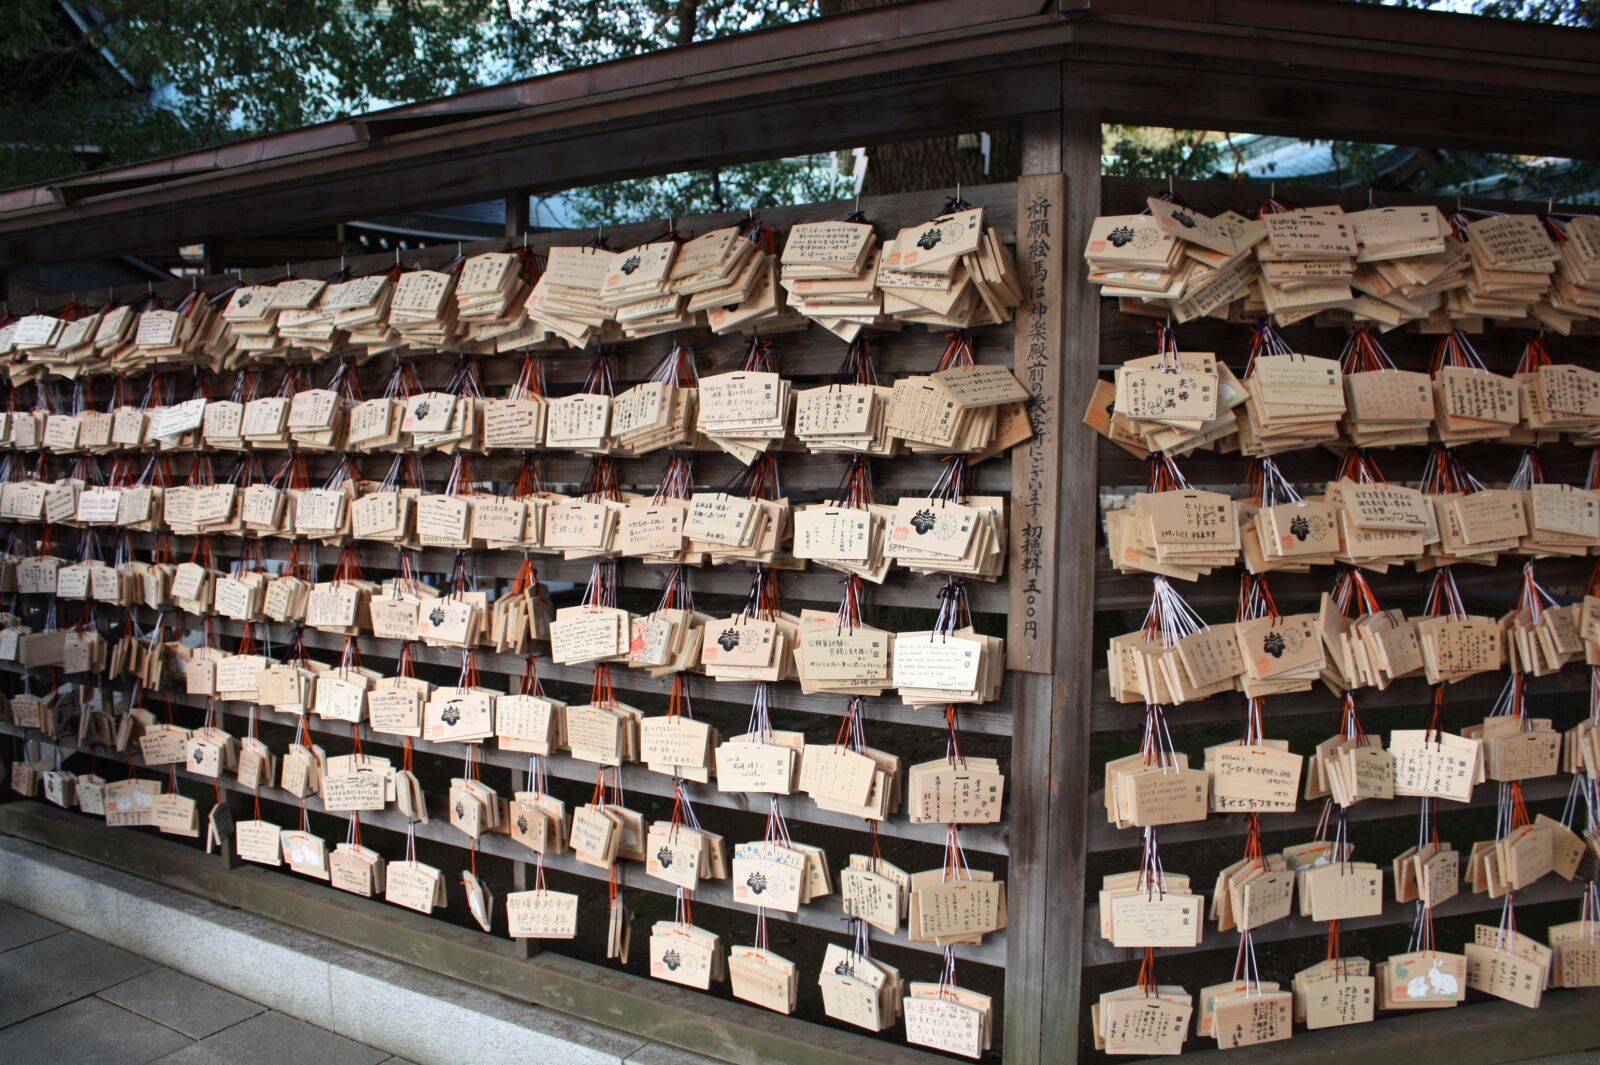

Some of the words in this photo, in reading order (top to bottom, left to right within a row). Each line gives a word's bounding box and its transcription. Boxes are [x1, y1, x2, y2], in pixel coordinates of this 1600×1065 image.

[764, 383, 771, 400] 願意
[1164, 387, 1176, 409] 円満
[1178, 378, 1189, 402] 夫婦
[1202, 385, 1210, 402] 願意
[857, 397, 865, 414] 願意
[1217, 505, 1226, 523] 願意
[857, 523, 864, 540] 願意
[961, 515, 972, 533] 祈願
[871, 641, 880, 657] 願意
[989, 786, 997, 803] 願意
